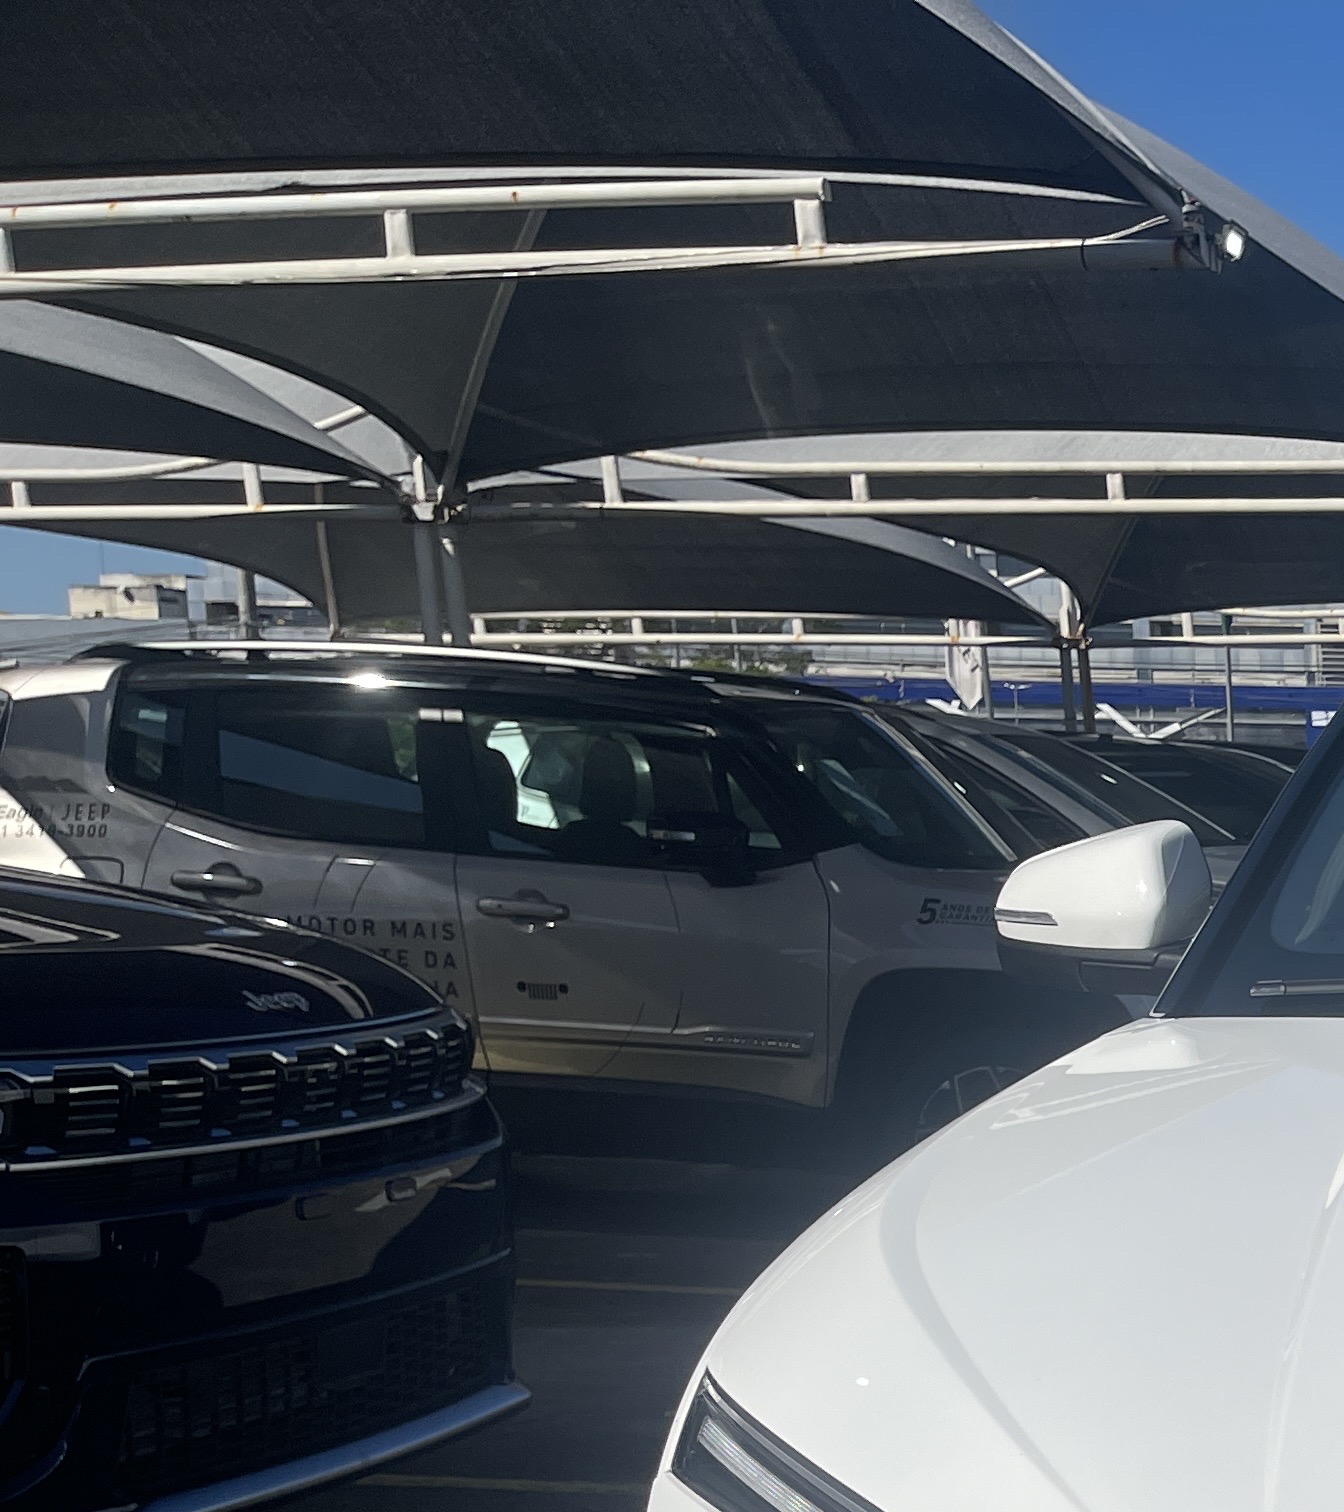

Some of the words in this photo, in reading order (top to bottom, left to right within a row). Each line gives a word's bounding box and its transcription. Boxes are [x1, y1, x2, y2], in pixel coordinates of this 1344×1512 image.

[61, 803, 110, 821] JEEP
[917, 898, 941, 924] 5
[390, 920, 456, 941] MAIS
[425, 950, 457, 970] DA
